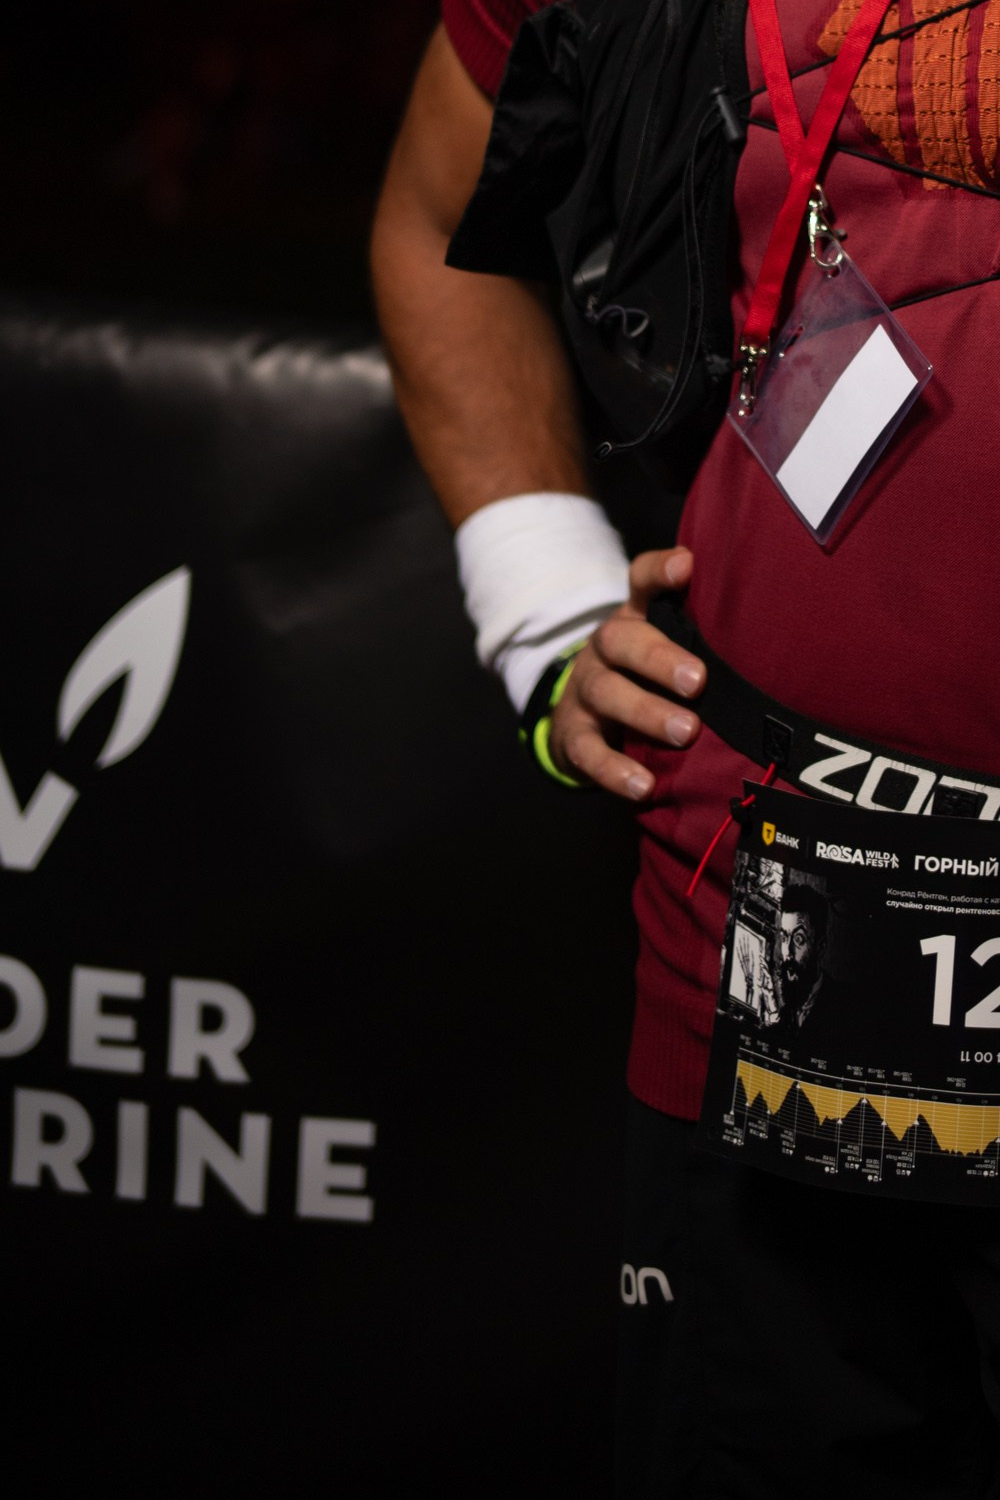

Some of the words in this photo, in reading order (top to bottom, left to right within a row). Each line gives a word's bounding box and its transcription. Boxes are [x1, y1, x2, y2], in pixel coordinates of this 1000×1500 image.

[775, 831, 800, 850] БАНК
[865, 849, 891, 860] WILD
[865, 858, 890, 869] FEST
[913, 854, 1000, 878] ГОРНЫЙ
[886, 887, 916, 898] Конрад
[885, 899, 924, 911] случайно
[924, 903, 955, 914] открыл
[960, 1050, 970, 1062] 11
[974, 1051, 994, 1063] 00
[10, 1083, 378, 1227] RINE
[620, 1263, 675, 1305] on
